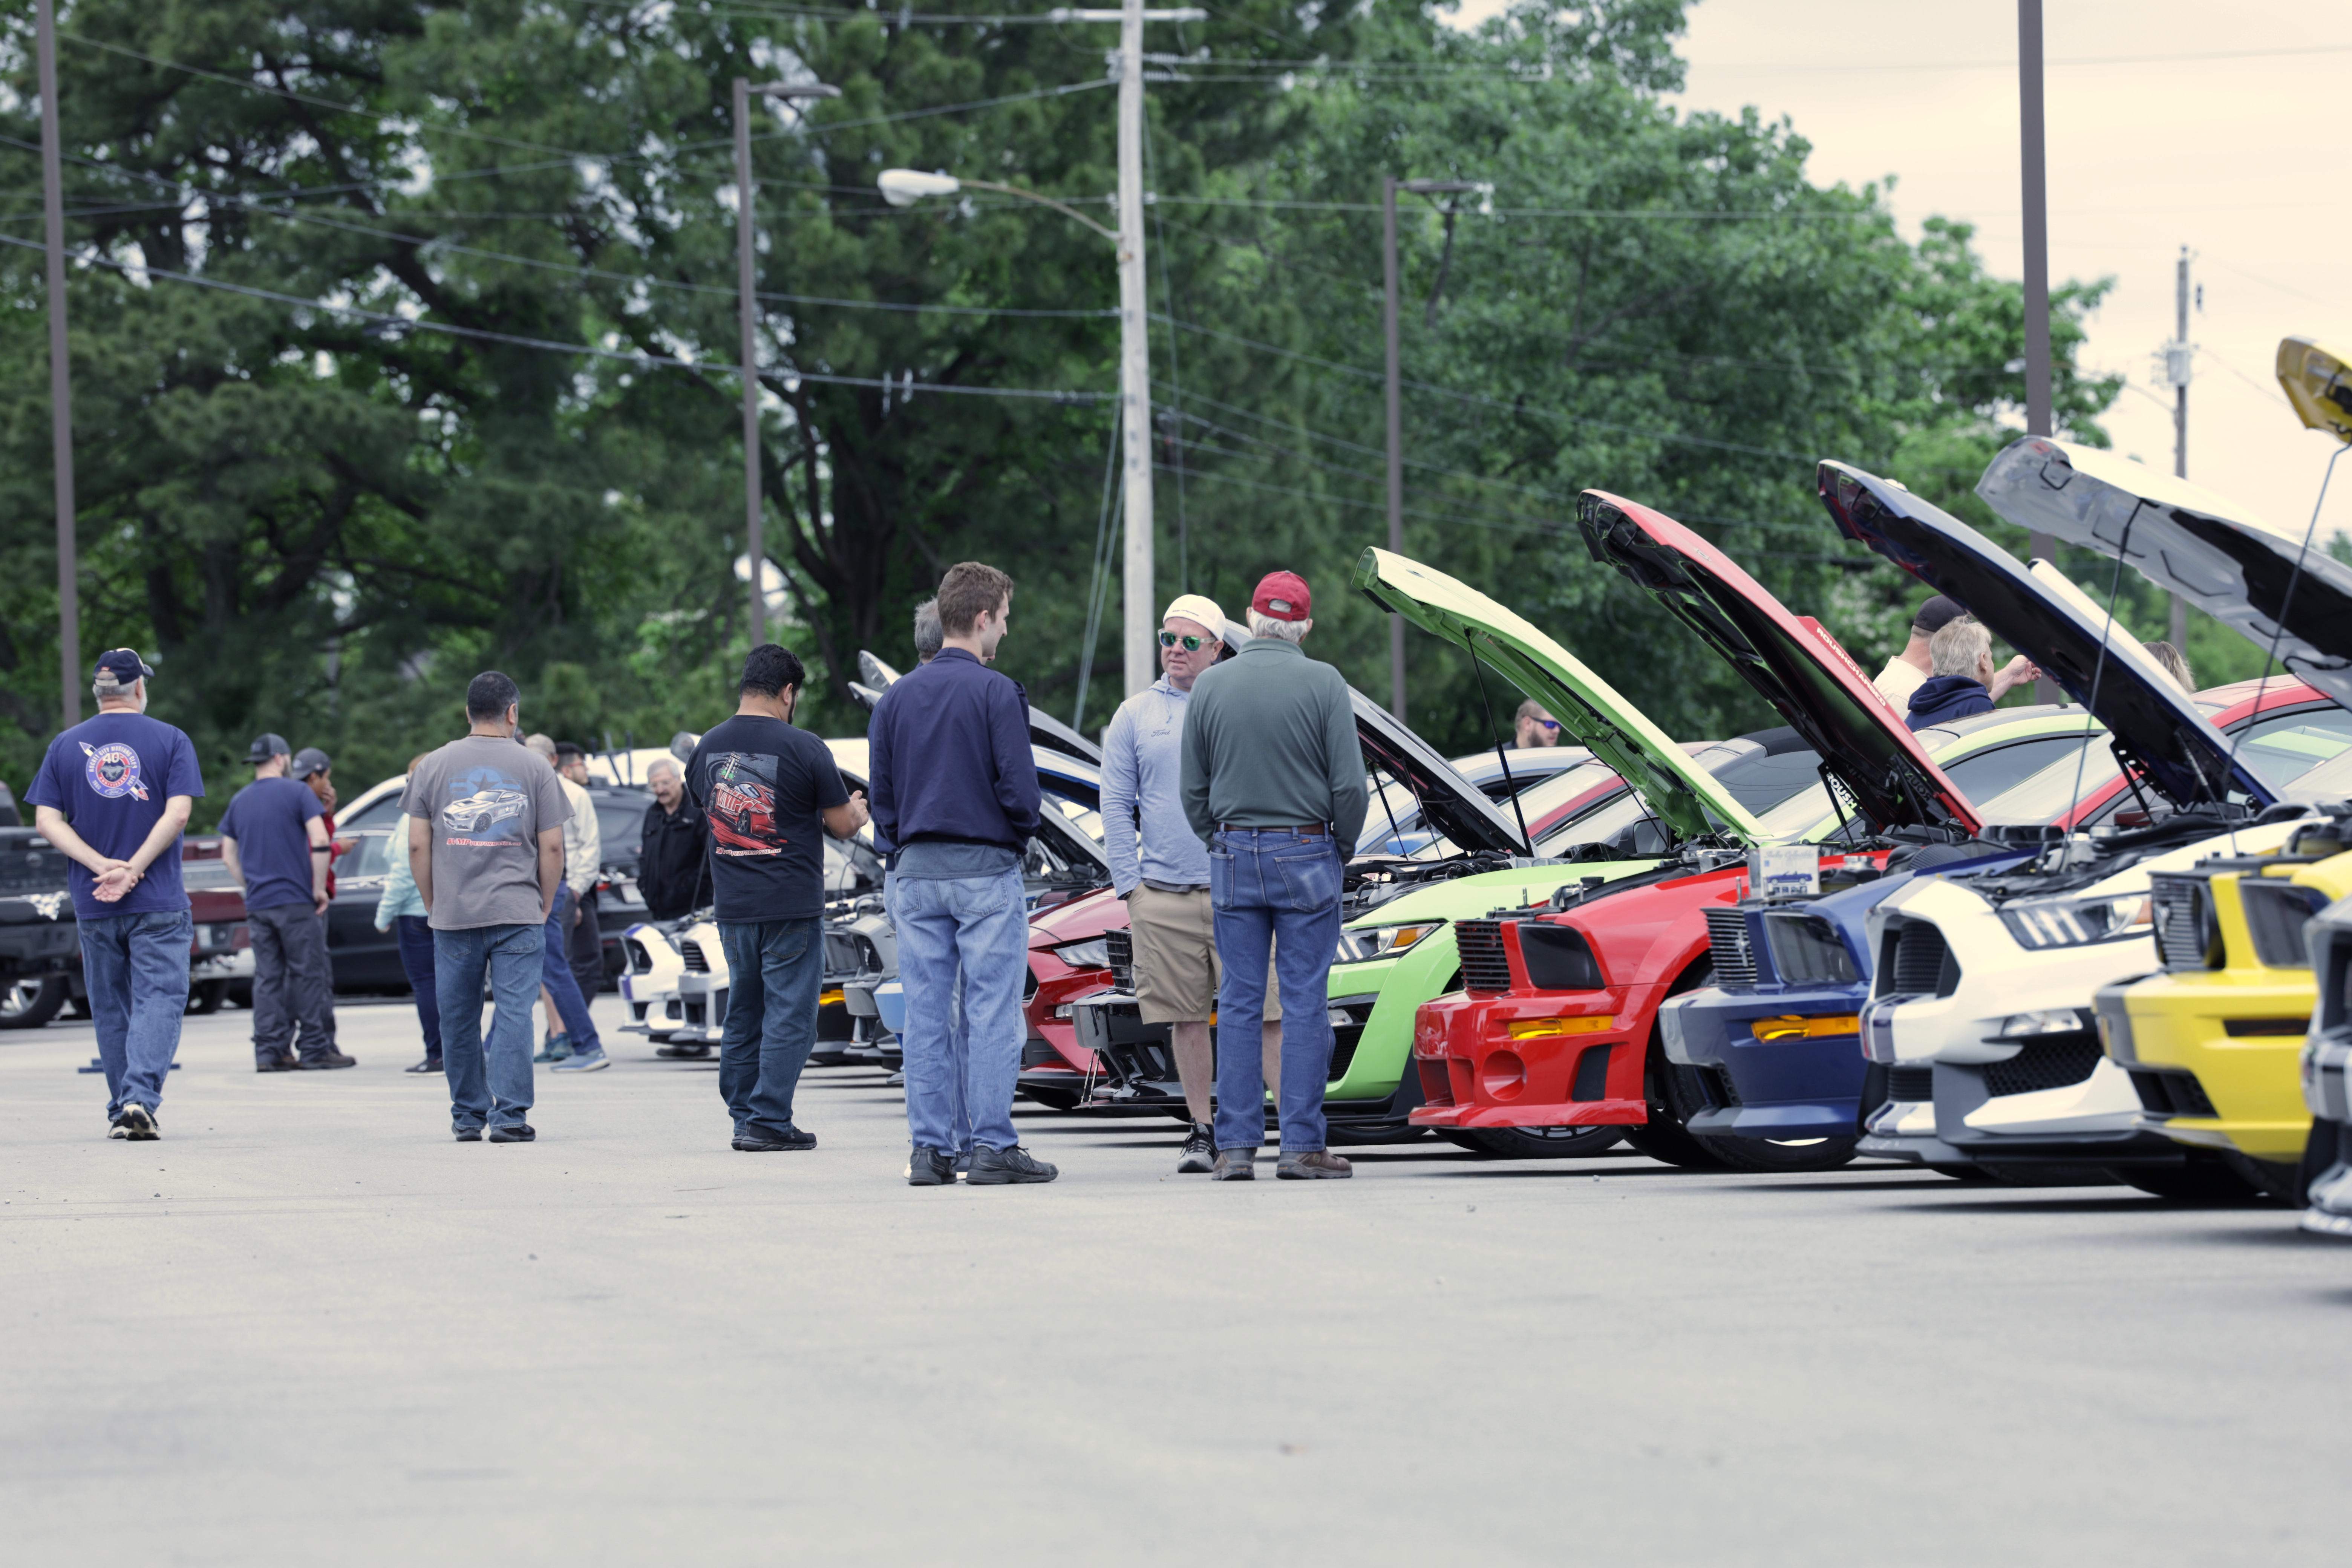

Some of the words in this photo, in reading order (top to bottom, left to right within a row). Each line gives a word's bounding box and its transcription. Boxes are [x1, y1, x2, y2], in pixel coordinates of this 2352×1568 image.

[1817, 627, 1886, 706] ROUSHCHARGED
[89, 754, 100, 772] ROCKET
[98, 747, 110, 756] CITY
[111, 746, 132, 758] MUSTANG
[1826, 772, 1857, 809] ROUSH
